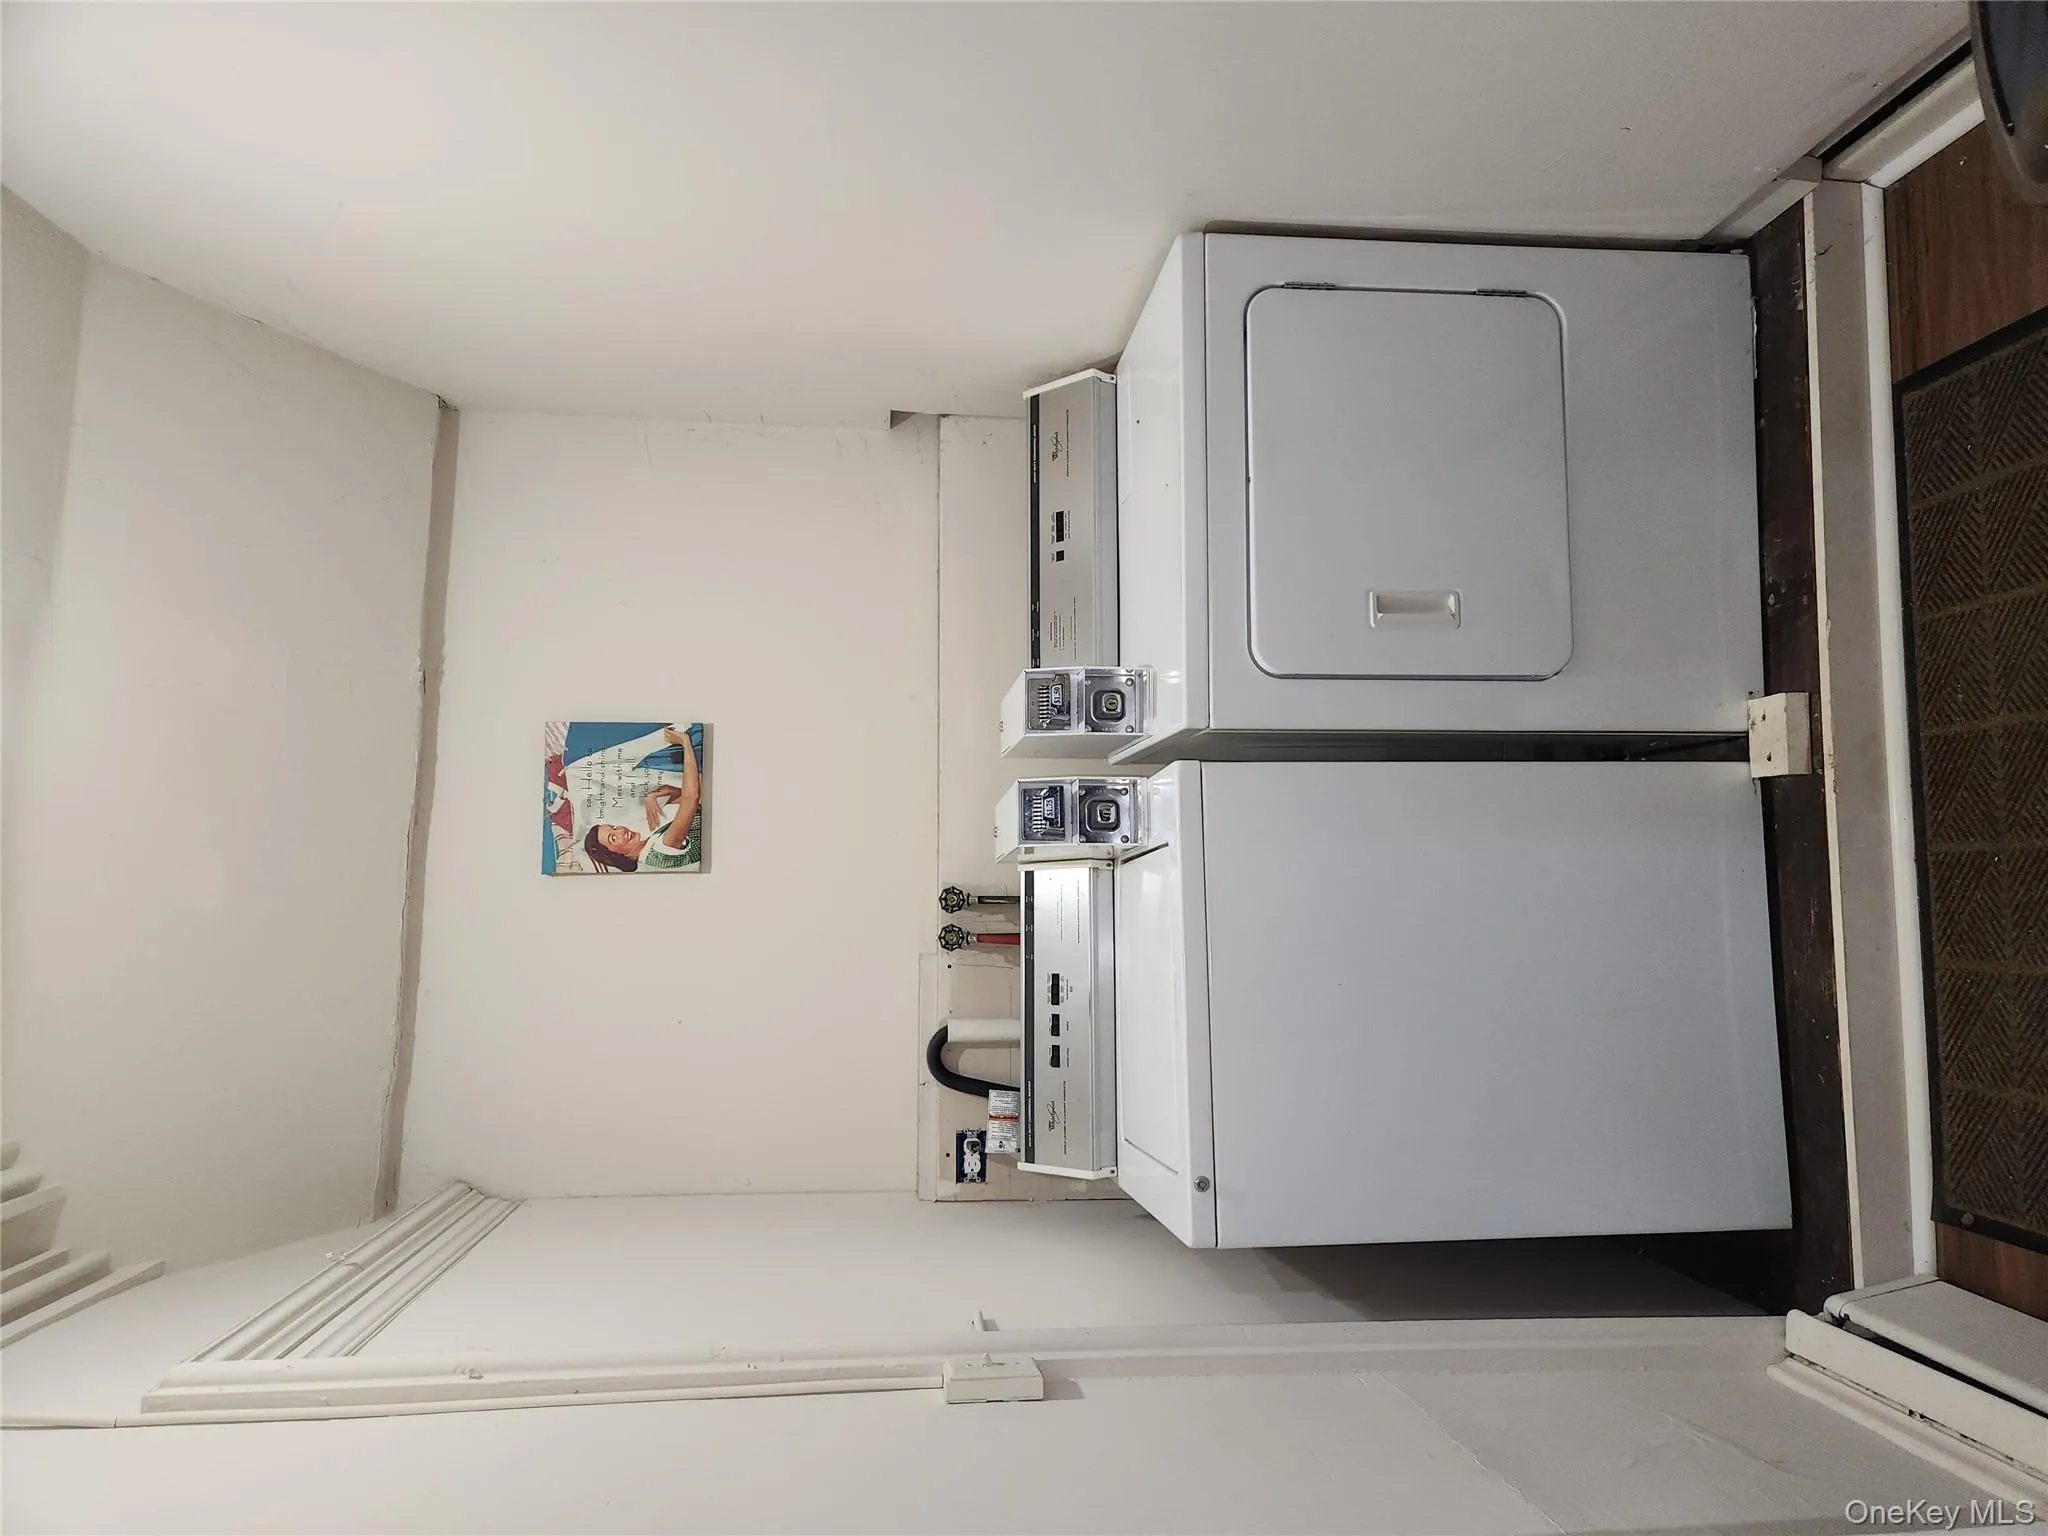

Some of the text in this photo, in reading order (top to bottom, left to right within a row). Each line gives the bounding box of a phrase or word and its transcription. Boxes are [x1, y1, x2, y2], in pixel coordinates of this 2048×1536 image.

[1052, 687, 1061, 704] $1.50
[584, 748, 592, 756] to
[579, 760, 592, 790] Hello
[596, 772, 606, 788] and
[610, 748, 623, 808] Mess with me
[626, 782, 636, 798] and
[639, 780, 649, 798] kick
[594, 792, 606, 819] bright
[1045, 799, 1054, 817] $1.75
[1046, 1100, 1060, 1132] Whirlpool
